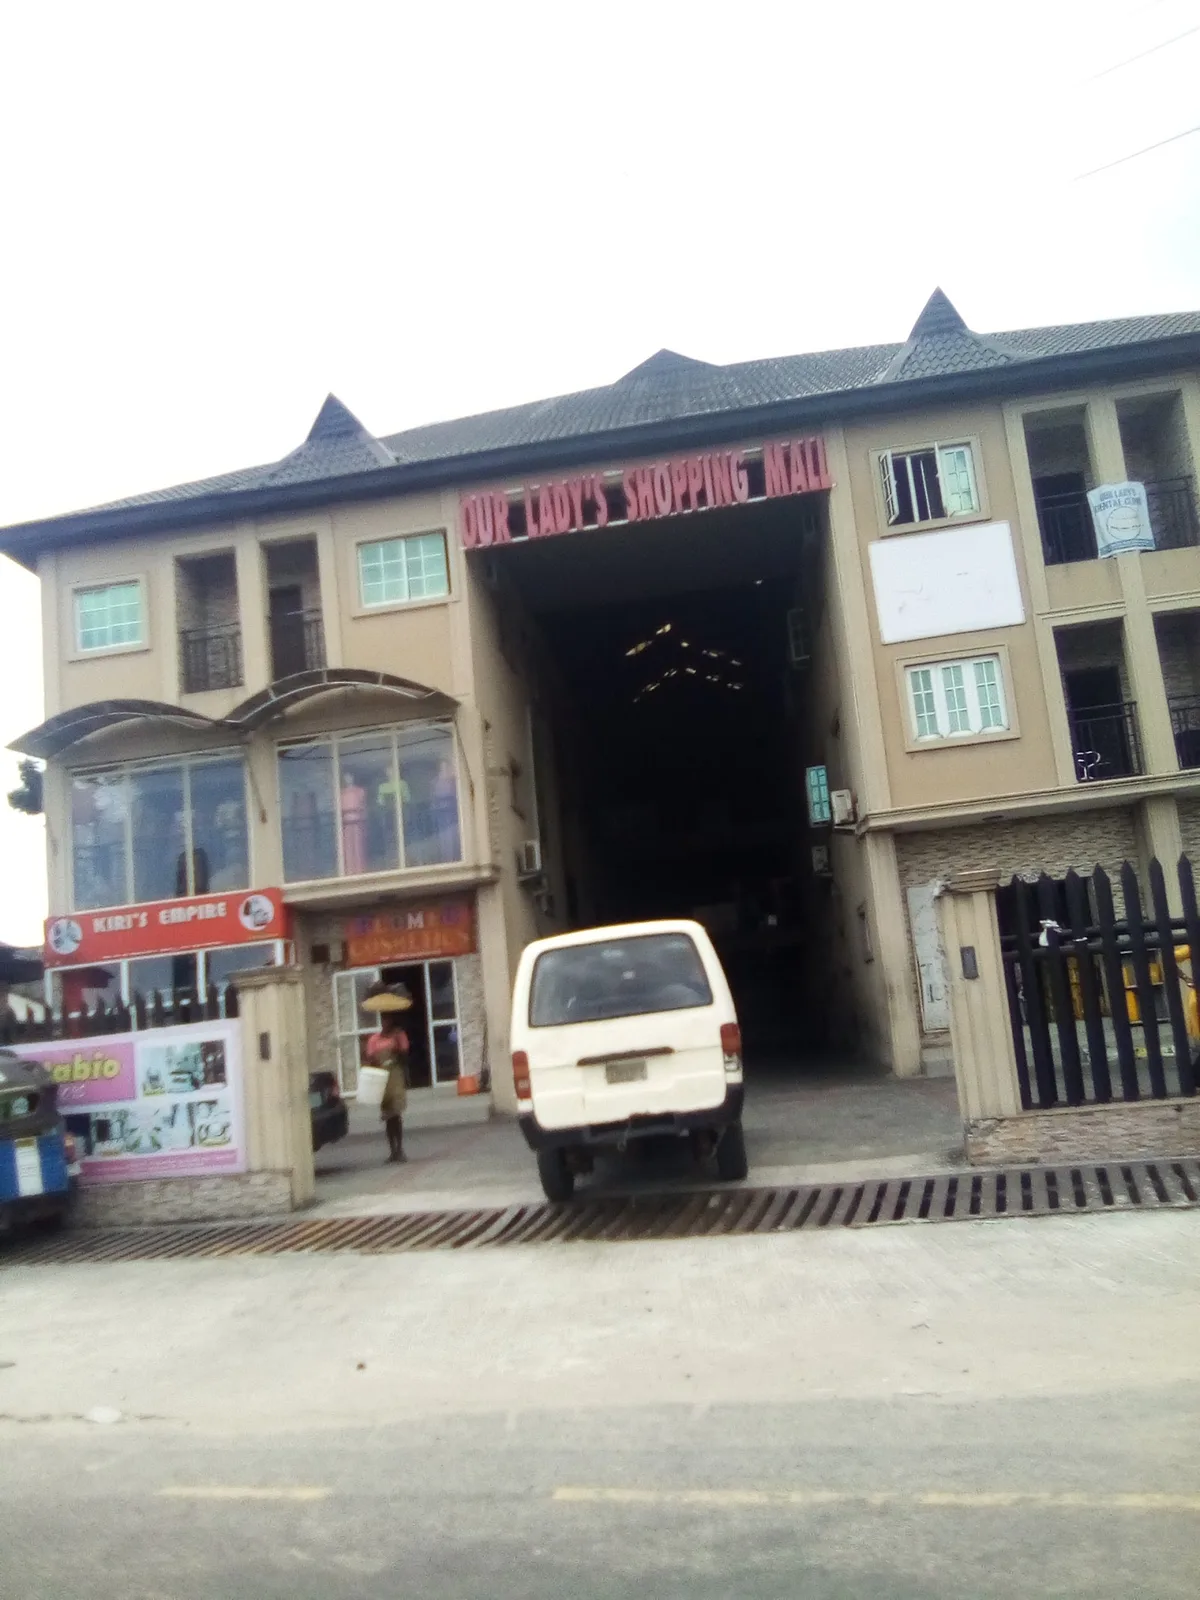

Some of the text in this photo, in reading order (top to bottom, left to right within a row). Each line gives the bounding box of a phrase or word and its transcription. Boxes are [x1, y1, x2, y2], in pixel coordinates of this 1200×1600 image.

[459, 437, 832, 548] OUR LADY'S SHOPPING MALL
[159, 901, 228, 925] EMPIRE
